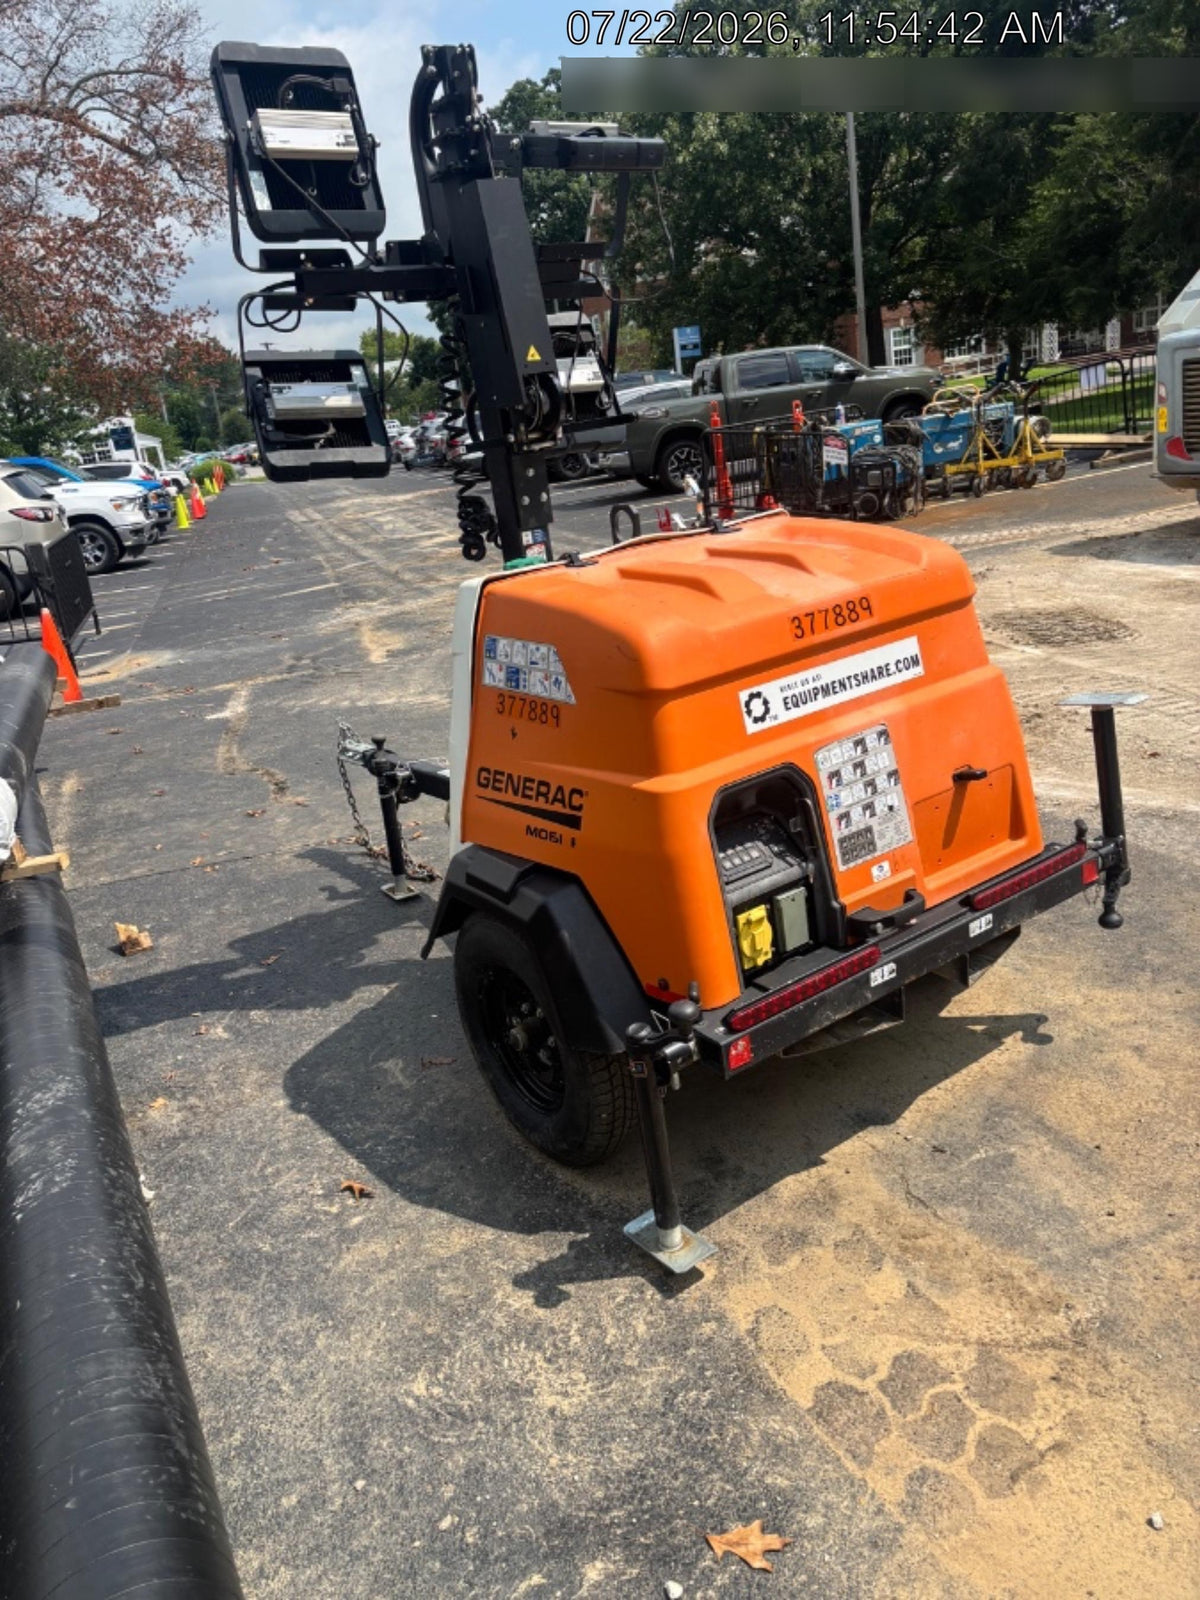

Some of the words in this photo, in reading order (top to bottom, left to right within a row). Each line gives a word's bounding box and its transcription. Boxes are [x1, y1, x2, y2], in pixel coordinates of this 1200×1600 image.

[791, 597, 873, 639] 377889
[782, 653, 921, 712] EQUIPMENTSHARE.COM
[496, 692, 560, 728] 377889
[477, 766, 584, 812] GENERAC
